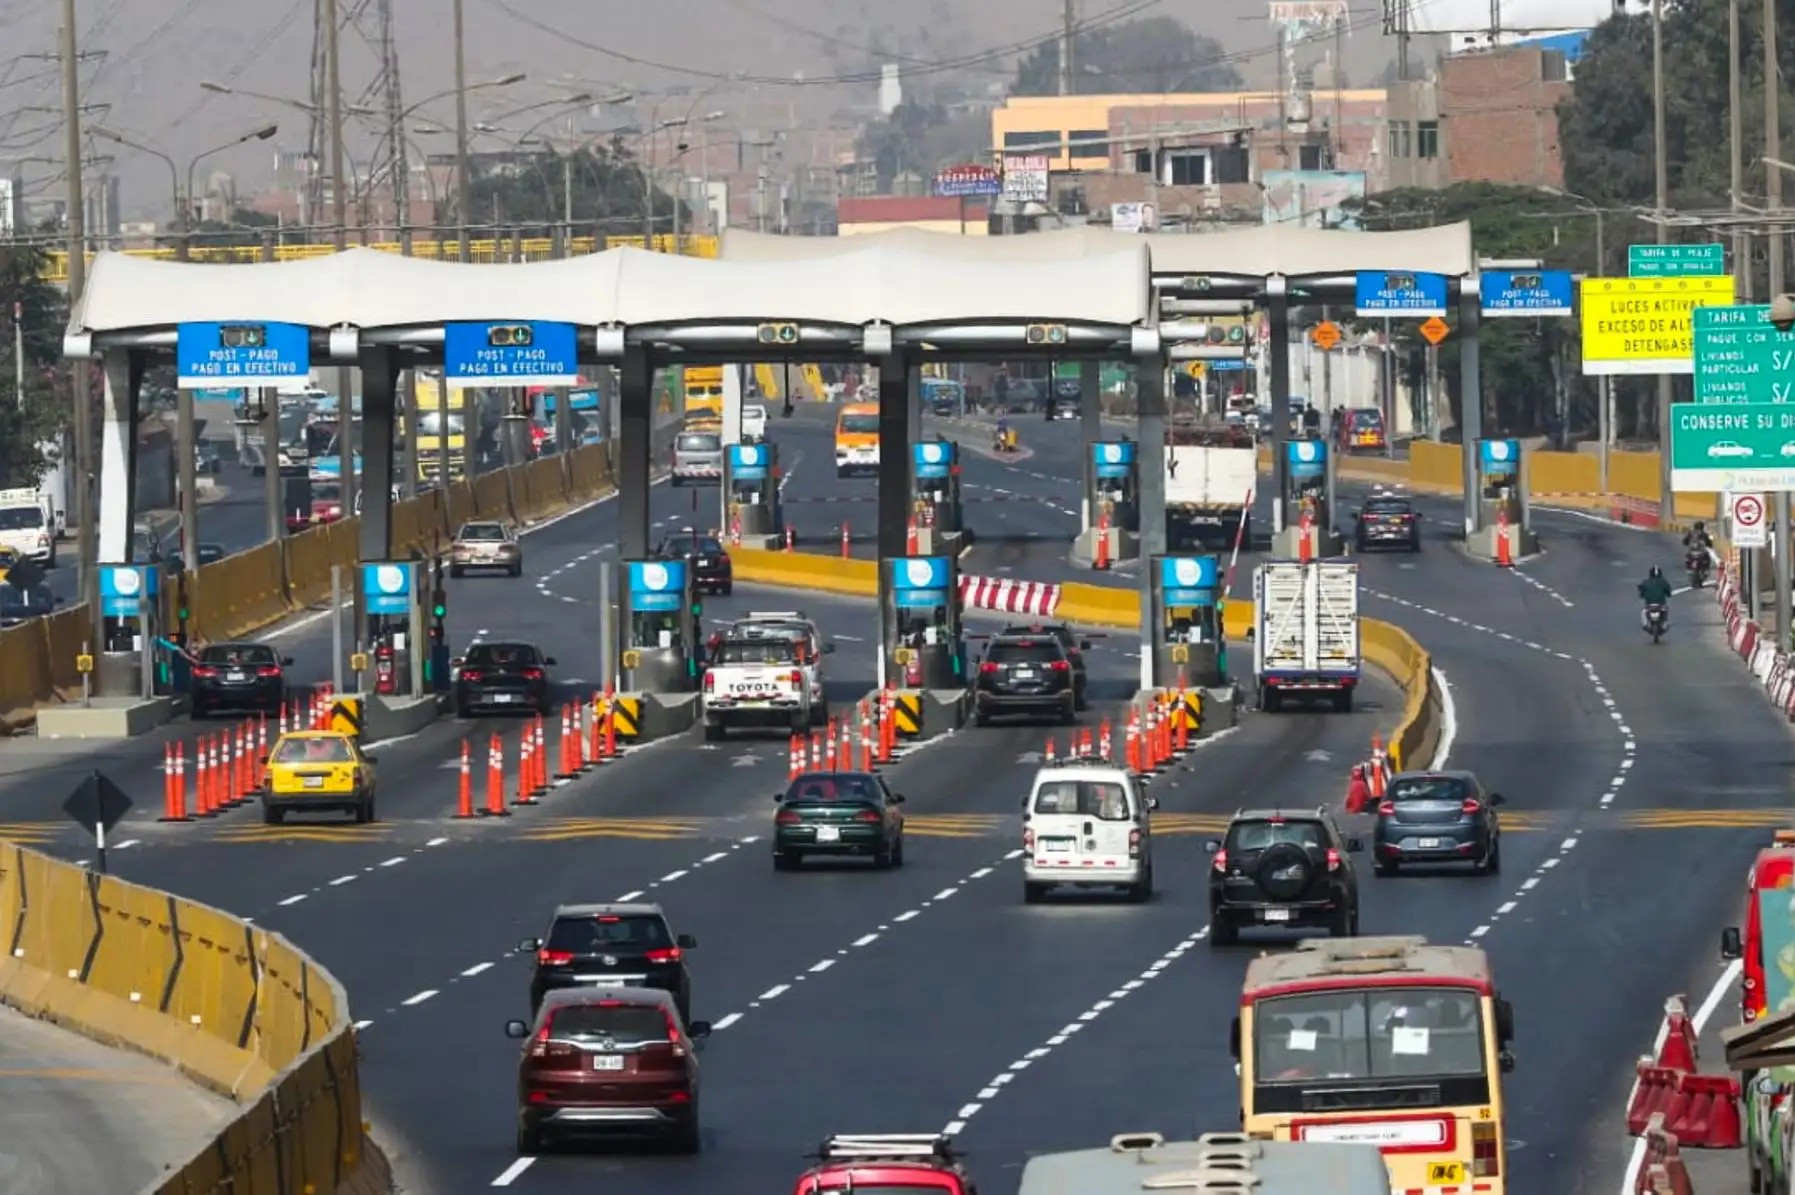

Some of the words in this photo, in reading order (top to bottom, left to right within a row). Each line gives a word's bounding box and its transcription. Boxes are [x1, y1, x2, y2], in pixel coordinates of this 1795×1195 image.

[1610, 300, 1649, 314] LUCES
[1708, 311, 1746, 323] TARIFA
[1598, 319, 1645, 333] EXCESO
[1650, 319, 1665, 332] DE
[209, 349, 237, 361] POST
[249, 349, 278, 361] PAGO
[477, 349, 504, 361] POST
[517, 349, 546, 361] PAGO
[191, 363, 221, 374] PAGO
[226, 362, 240, 374] EN
[245, 361, 297, 374] EFECTIVO
[459, 363, 488, 374] PAGO
[494, 362, 508, 374] EN
[513, 361, 564, 374] EFECTIVO
[1702, 363, 1759, 374] PARTICULAR
[1702, 382, 1746, 393] LIVIANOS
[1681, 414, 1749, 430] CONSERVE
[1757, 414, 1773, 429] SU
[729, 682, 779, 693] TOYOTA
